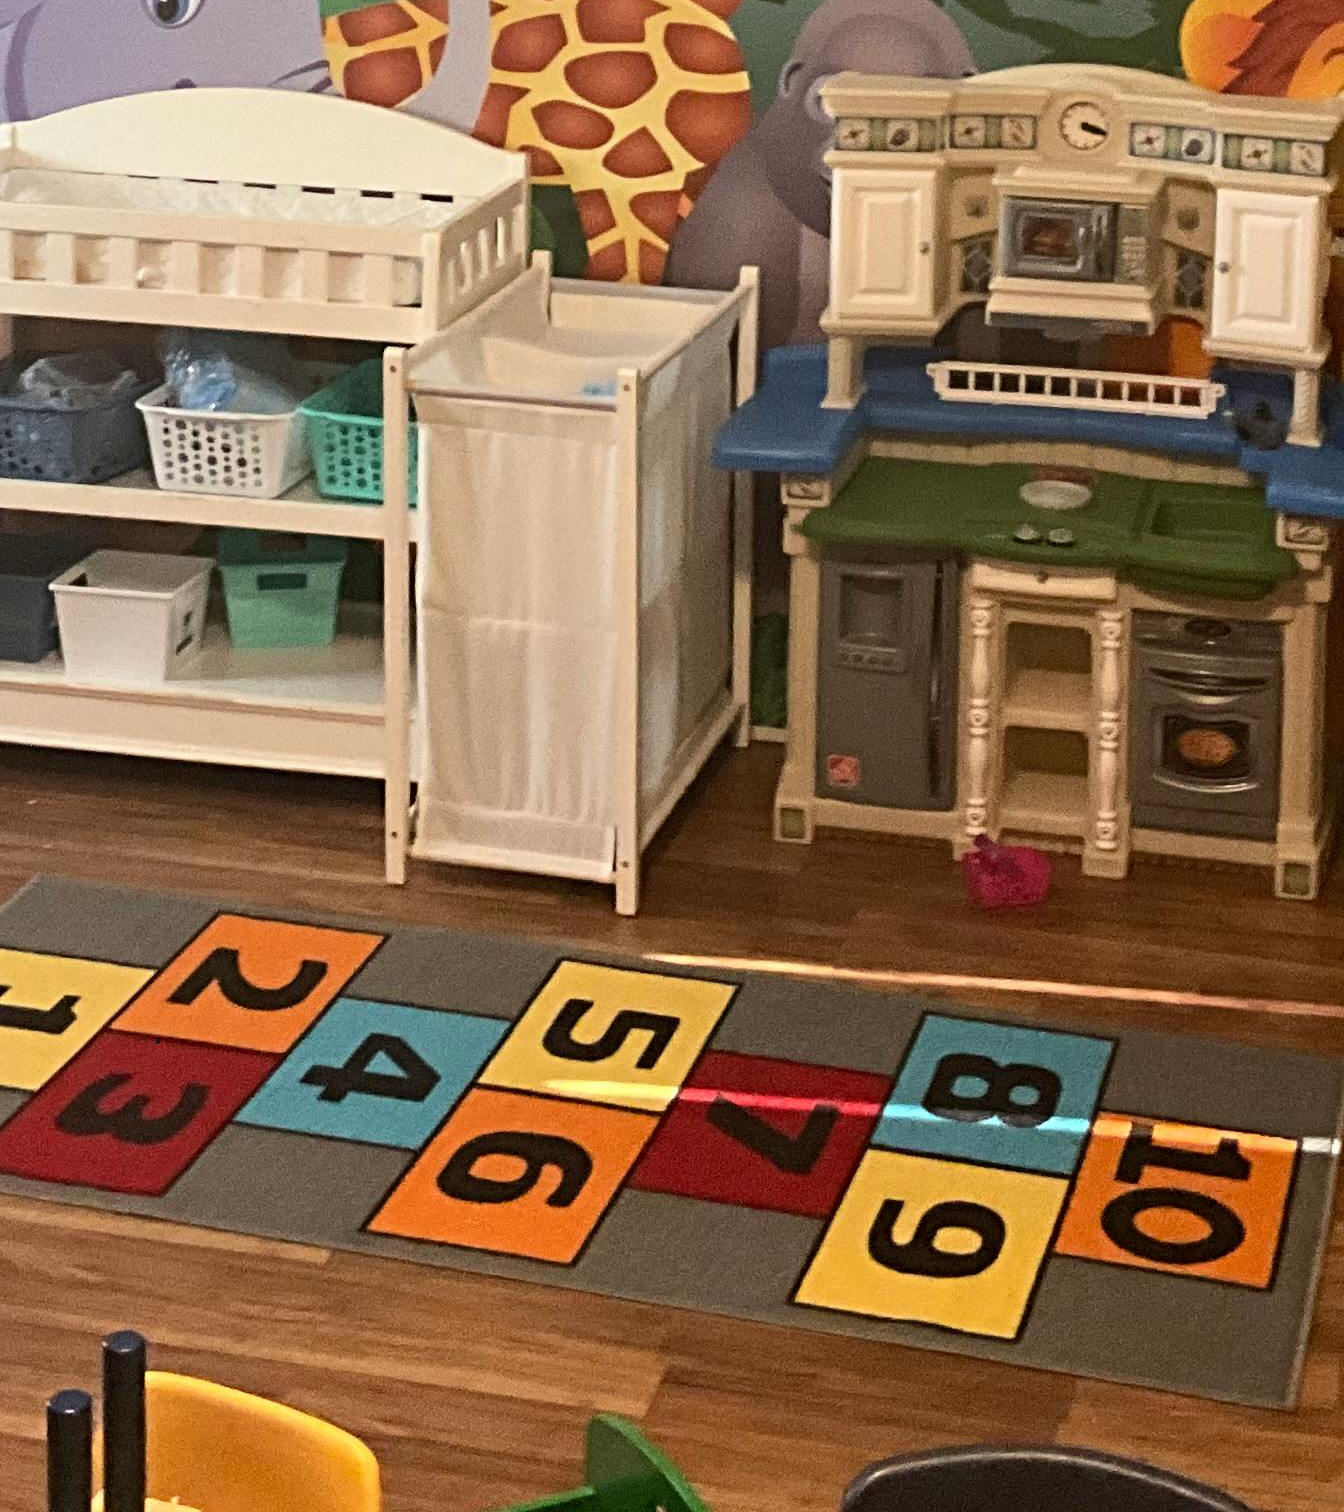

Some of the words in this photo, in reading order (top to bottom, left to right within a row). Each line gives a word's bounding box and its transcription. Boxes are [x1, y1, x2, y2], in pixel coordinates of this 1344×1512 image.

[167, 948, 328, 1011] 2
[299, 1033, 442, 1103] 4
[542, 999, 680, 1069] 5
[53, 1071, 209, 1146] 3
[922, 1053, 1063, 1128] 8
[436, 1131, 593, 1208] 6
[706, 1094, 840, 1175] 7
[1101, 1121, 1251, 1265] 10
[868, 1199, 1006, 1278] 9
